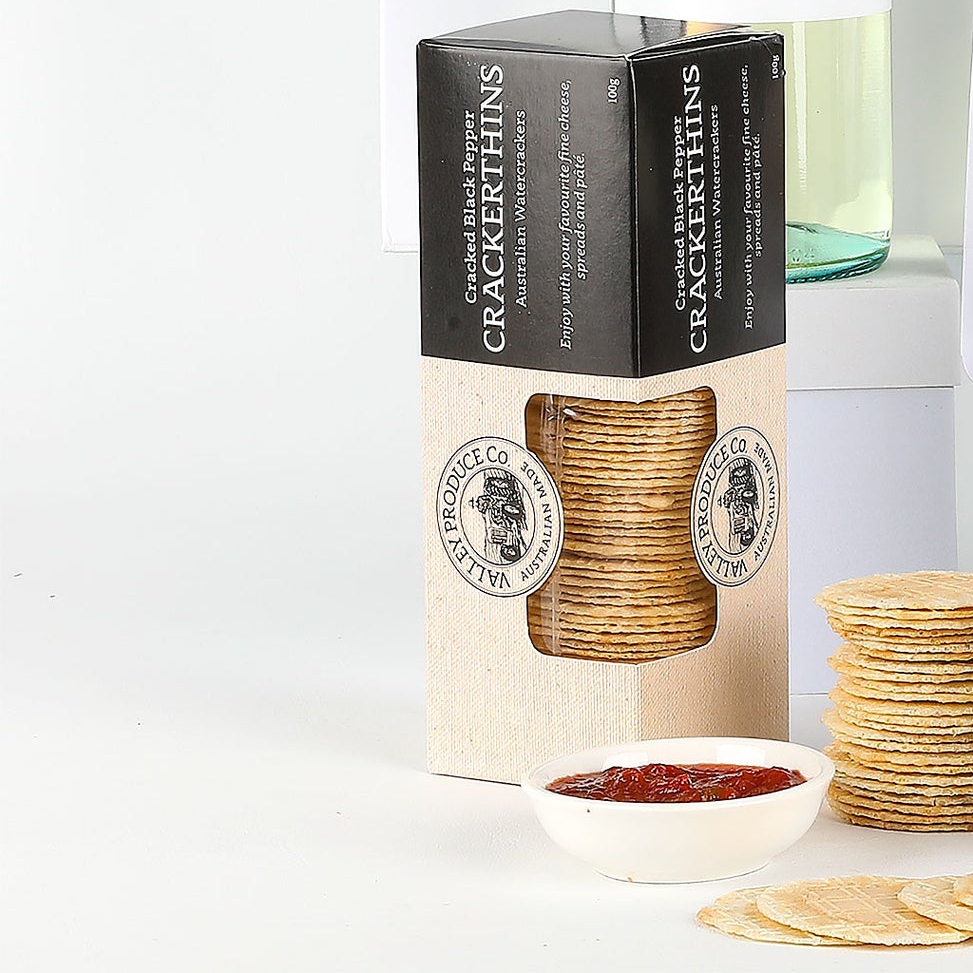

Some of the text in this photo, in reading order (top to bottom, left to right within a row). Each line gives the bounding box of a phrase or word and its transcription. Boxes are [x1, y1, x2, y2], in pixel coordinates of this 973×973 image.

[607, 77, 620, 104] 100g
[771, 54, 780, 79] 100g
[463, 110, 478, 304] Cracked Black Pepper
[480, 64, 505, 353] CRACKERTHINS
[514, 110, 527, 308] Australian Watercrackers
[557, 79, 574, 350] Enjoy with your favourite fine cheese,
[572, 153, 588, 280] spreads and pâté.
[673, 115, 686, 311] Cracked Black Pepper
[682, 64, 707, 354] CRACKERTHINS
[710, 104, 723, 300] Australian Watercrackers
[741, 64, 754, 329] Enjoy with your favourite fine cheese,
[752, 170, 762, 199] and
[753, 202, 763, 258] spreads
[442, 448, 484, 533] PRODUCE
[520, 462, 553, 582] AUSTRALIAN MADE
[698, 444, 729, 541] PRODUCE
[753, 442, 776, 562] AUSTRALIAN MADE
[448, 537, 511, 588] VALLEY
[702, 540, 748, 578] VALLEY
